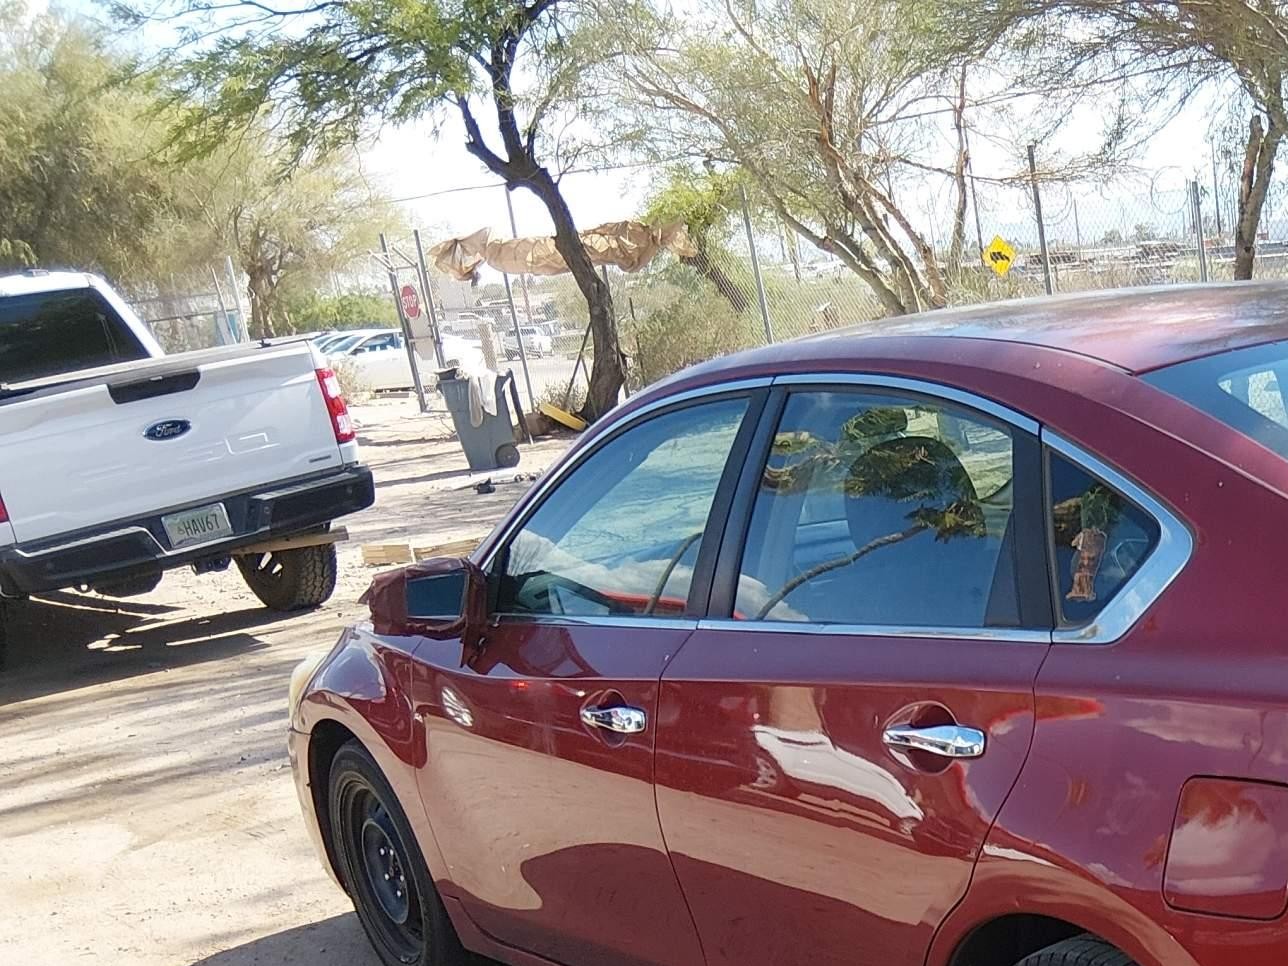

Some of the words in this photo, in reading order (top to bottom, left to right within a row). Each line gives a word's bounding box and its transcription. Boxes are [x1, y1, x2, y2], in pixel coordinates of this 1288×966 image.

[402, 294, 418, 310] STOP
[155, 422, 182, 437] Ford
[183, 513, 220, 537] HAV67
